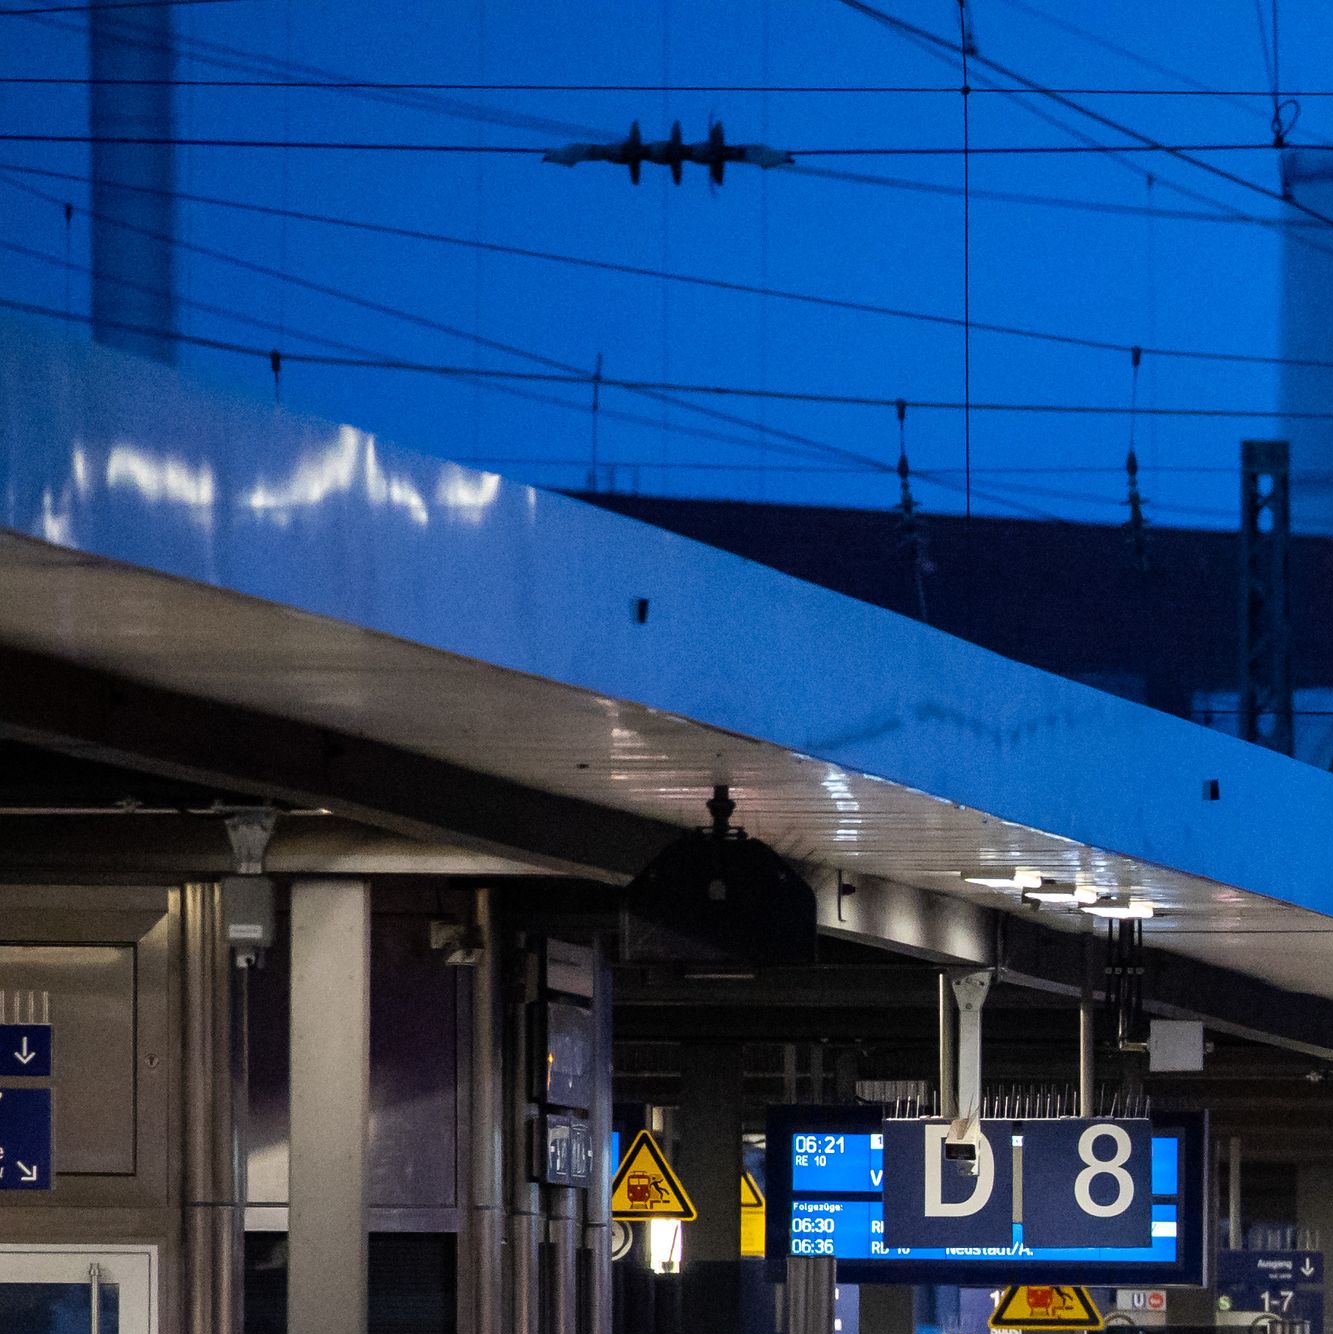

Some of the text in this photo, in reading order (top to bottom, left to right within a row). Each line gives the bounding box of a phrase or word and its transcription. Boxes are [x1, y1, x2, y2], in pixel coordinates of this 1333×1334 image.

[795, 1135, 845, 1154] 06:21
[795, 1155, 827, 1167] RE 10
[924, 1123, 1134, 1218] D 8
[791, 1218, 835, 1233] 06:30
[791, 1239, 834, 1254] 06:36
[1260, 1291, 1294, 1312] 1-7
